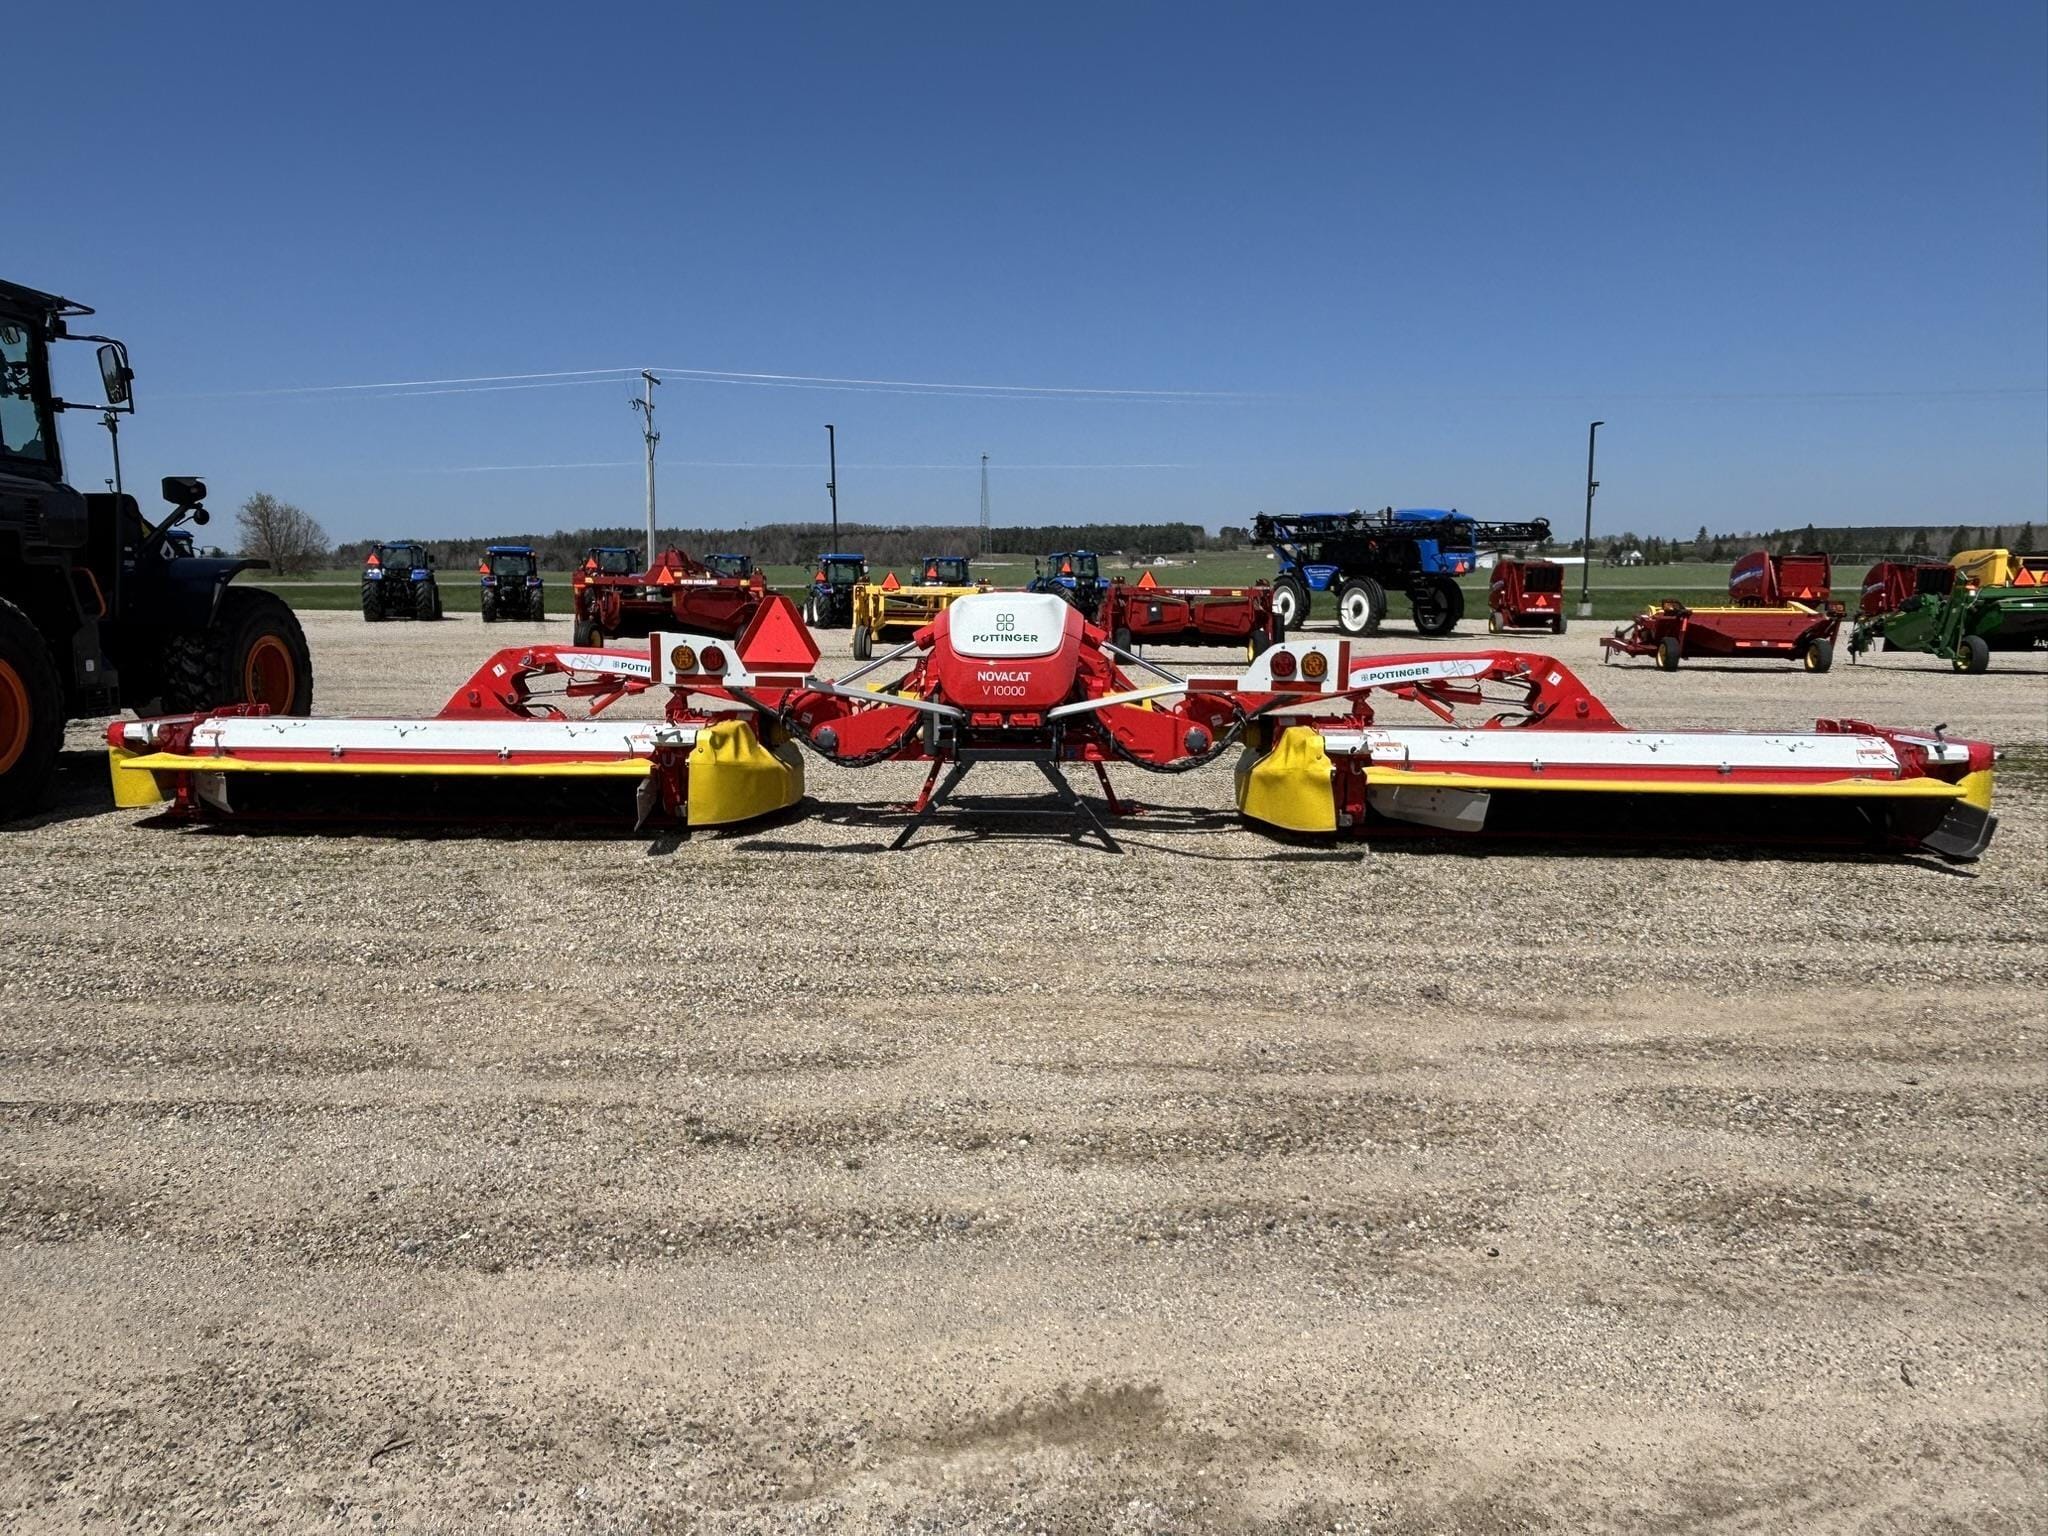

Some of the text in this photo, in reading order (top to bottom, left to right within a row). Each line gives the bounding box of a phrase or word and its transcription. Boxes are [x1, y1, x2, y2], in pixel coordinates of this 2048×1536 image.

[977, 671, 1032, 682] NOVACAT
[982, 685, 1026, 697] V 10000
